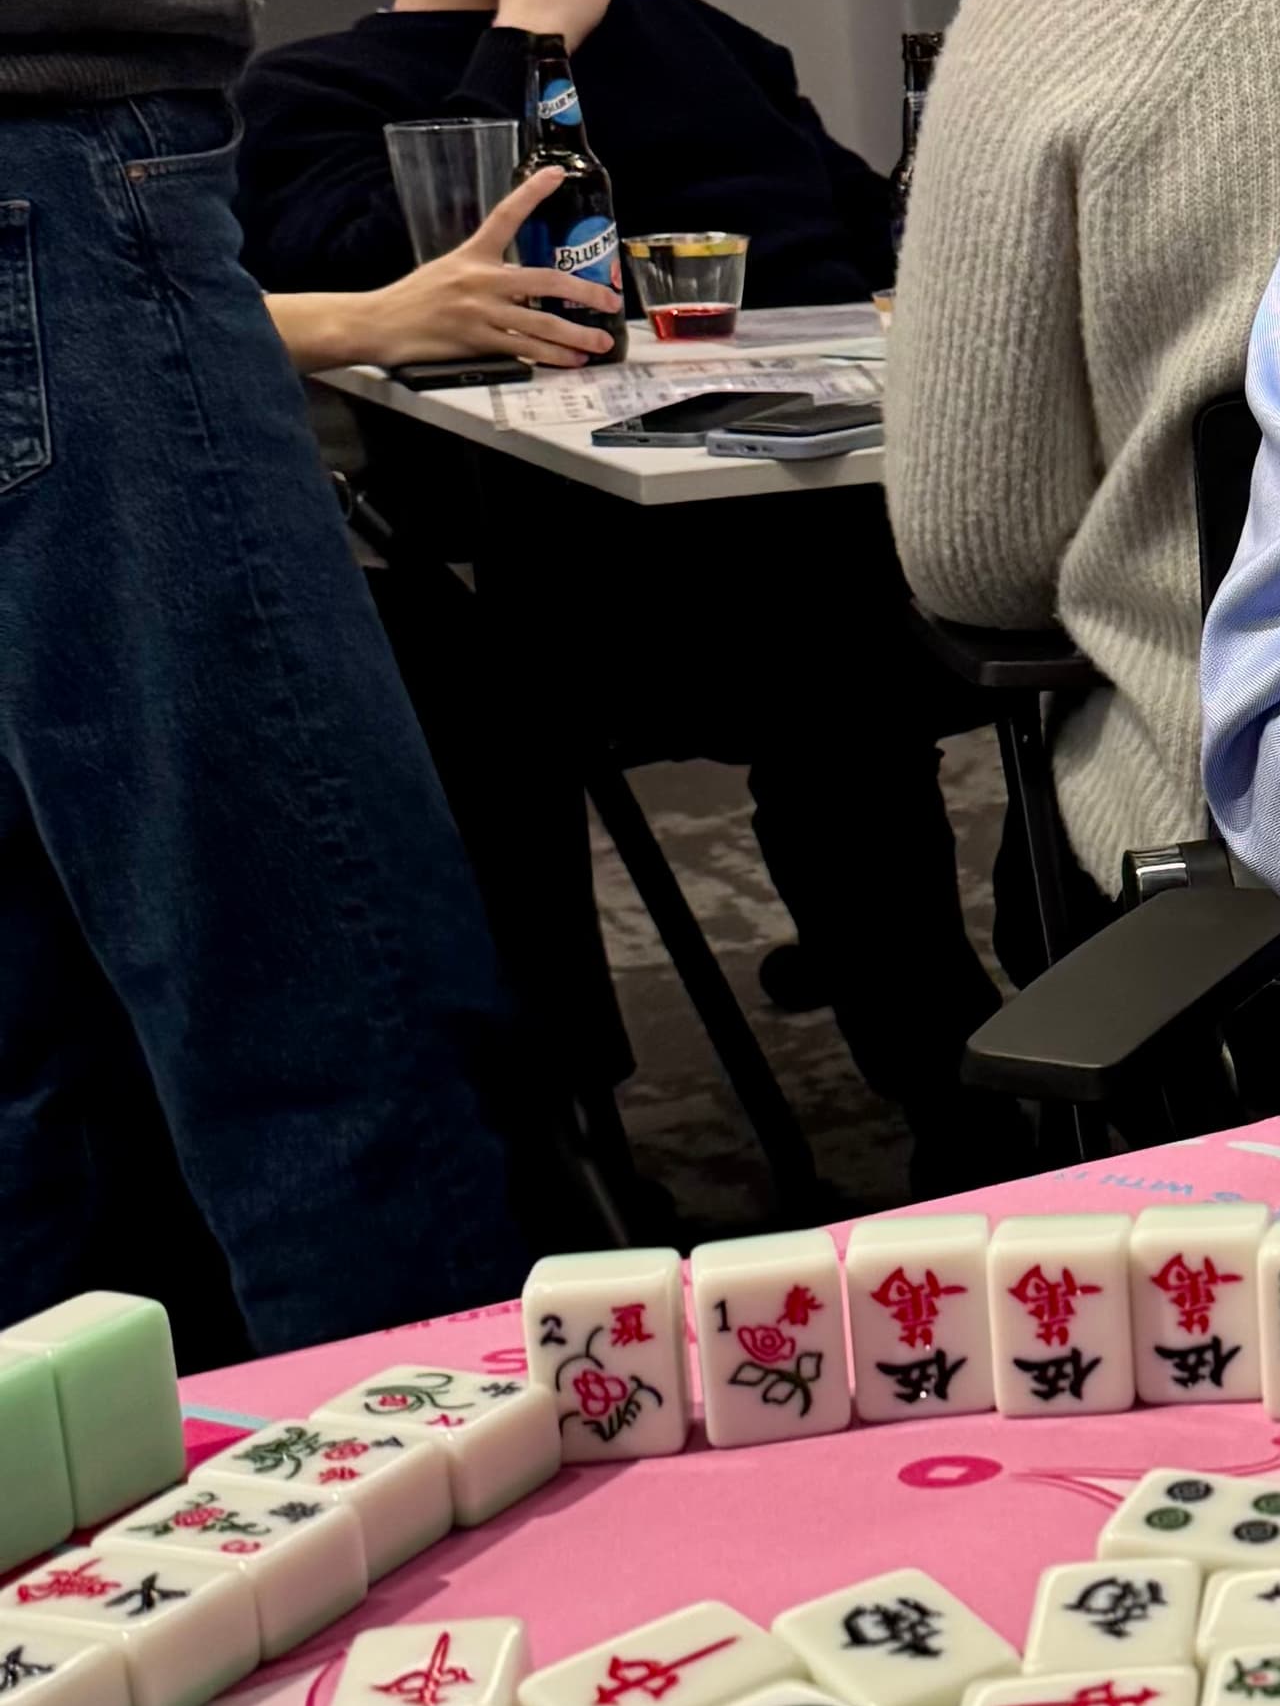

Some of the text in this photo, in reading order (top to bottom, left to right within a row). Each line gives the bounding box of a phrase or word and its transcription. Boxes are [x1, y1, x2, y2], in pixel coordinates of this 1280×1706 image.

[557, 240, 602, 272] BLUE
[540, 1314, 568, 1347] 2
[714, 1284, 824, 1333] 1 春
[843, 1599, 941, 1658] 南
[1067, 1578, 1165, 1638] 南
[596, 1639, 735, 1706] 中
